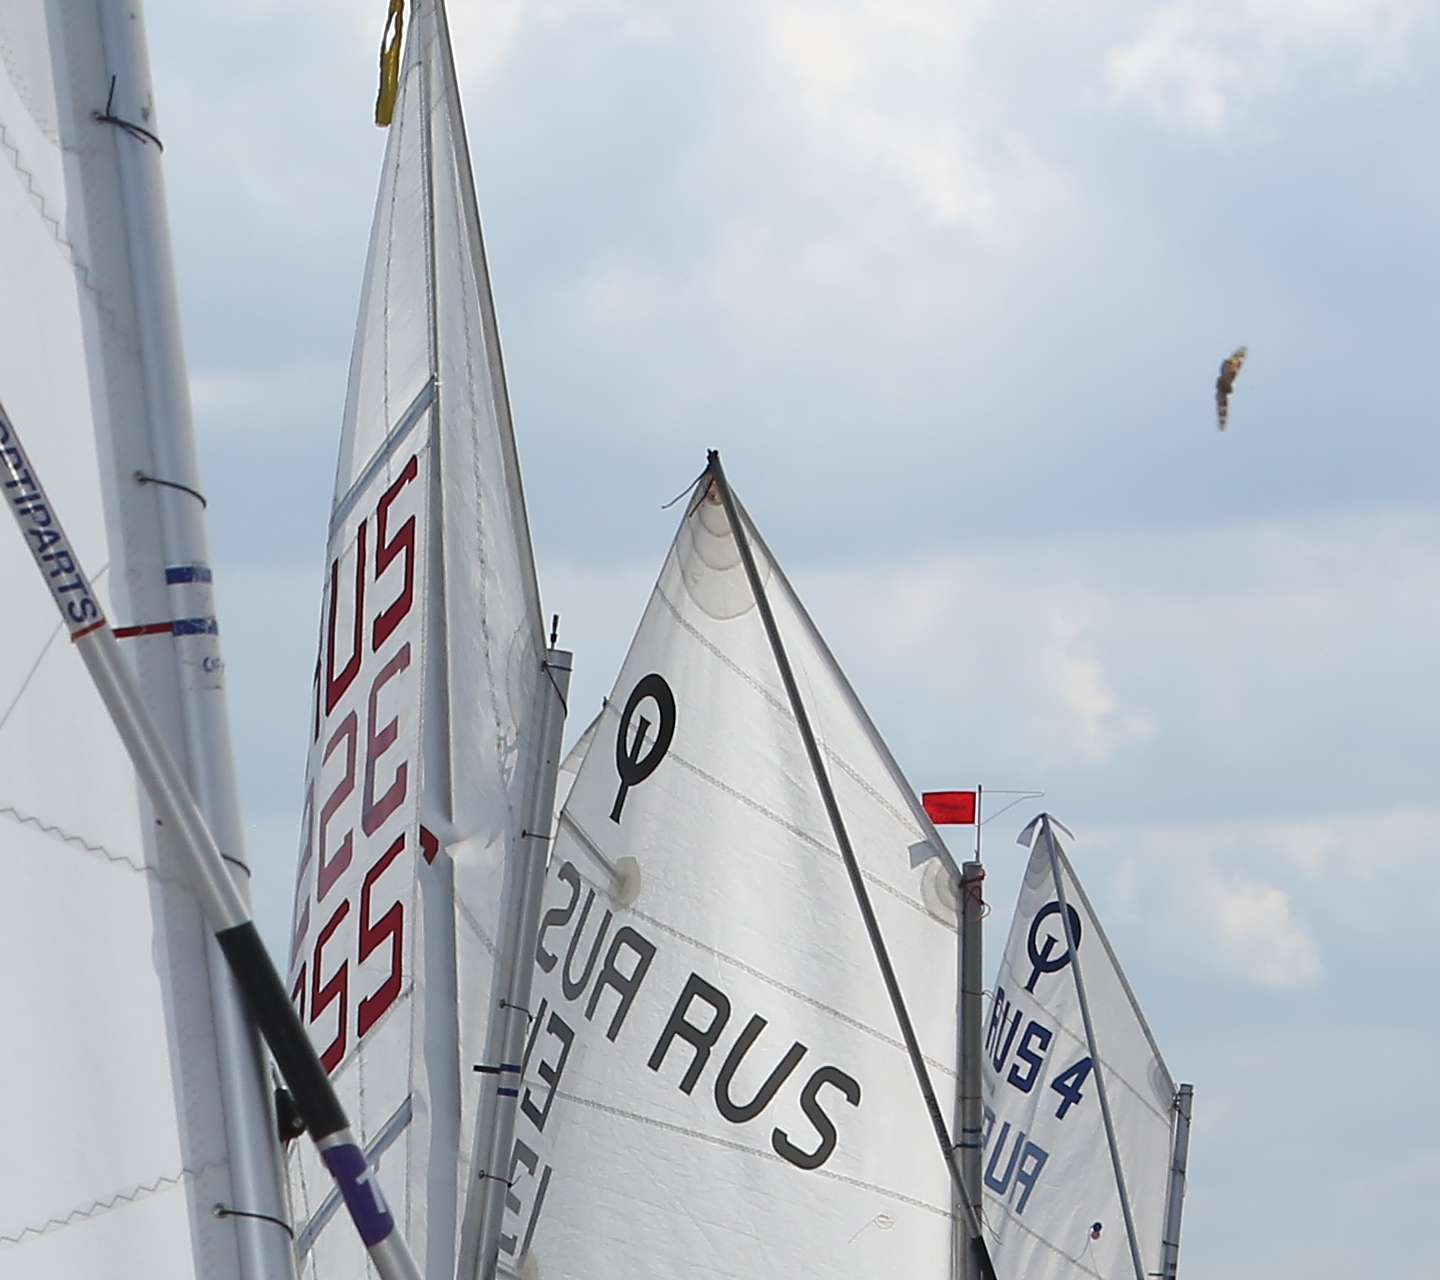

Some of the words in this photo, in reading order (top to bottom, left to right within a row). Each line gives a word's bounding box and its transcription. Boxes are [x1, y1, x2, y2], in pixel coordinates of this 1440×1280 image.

[314, 454, 417, 740] US
[290, 833, 405, 1076] 55
[985, 986, 1052, 1094] RUS
[1051, 1056, 1093, 1120] 4
[647, 972, 861, 1170] RUS
